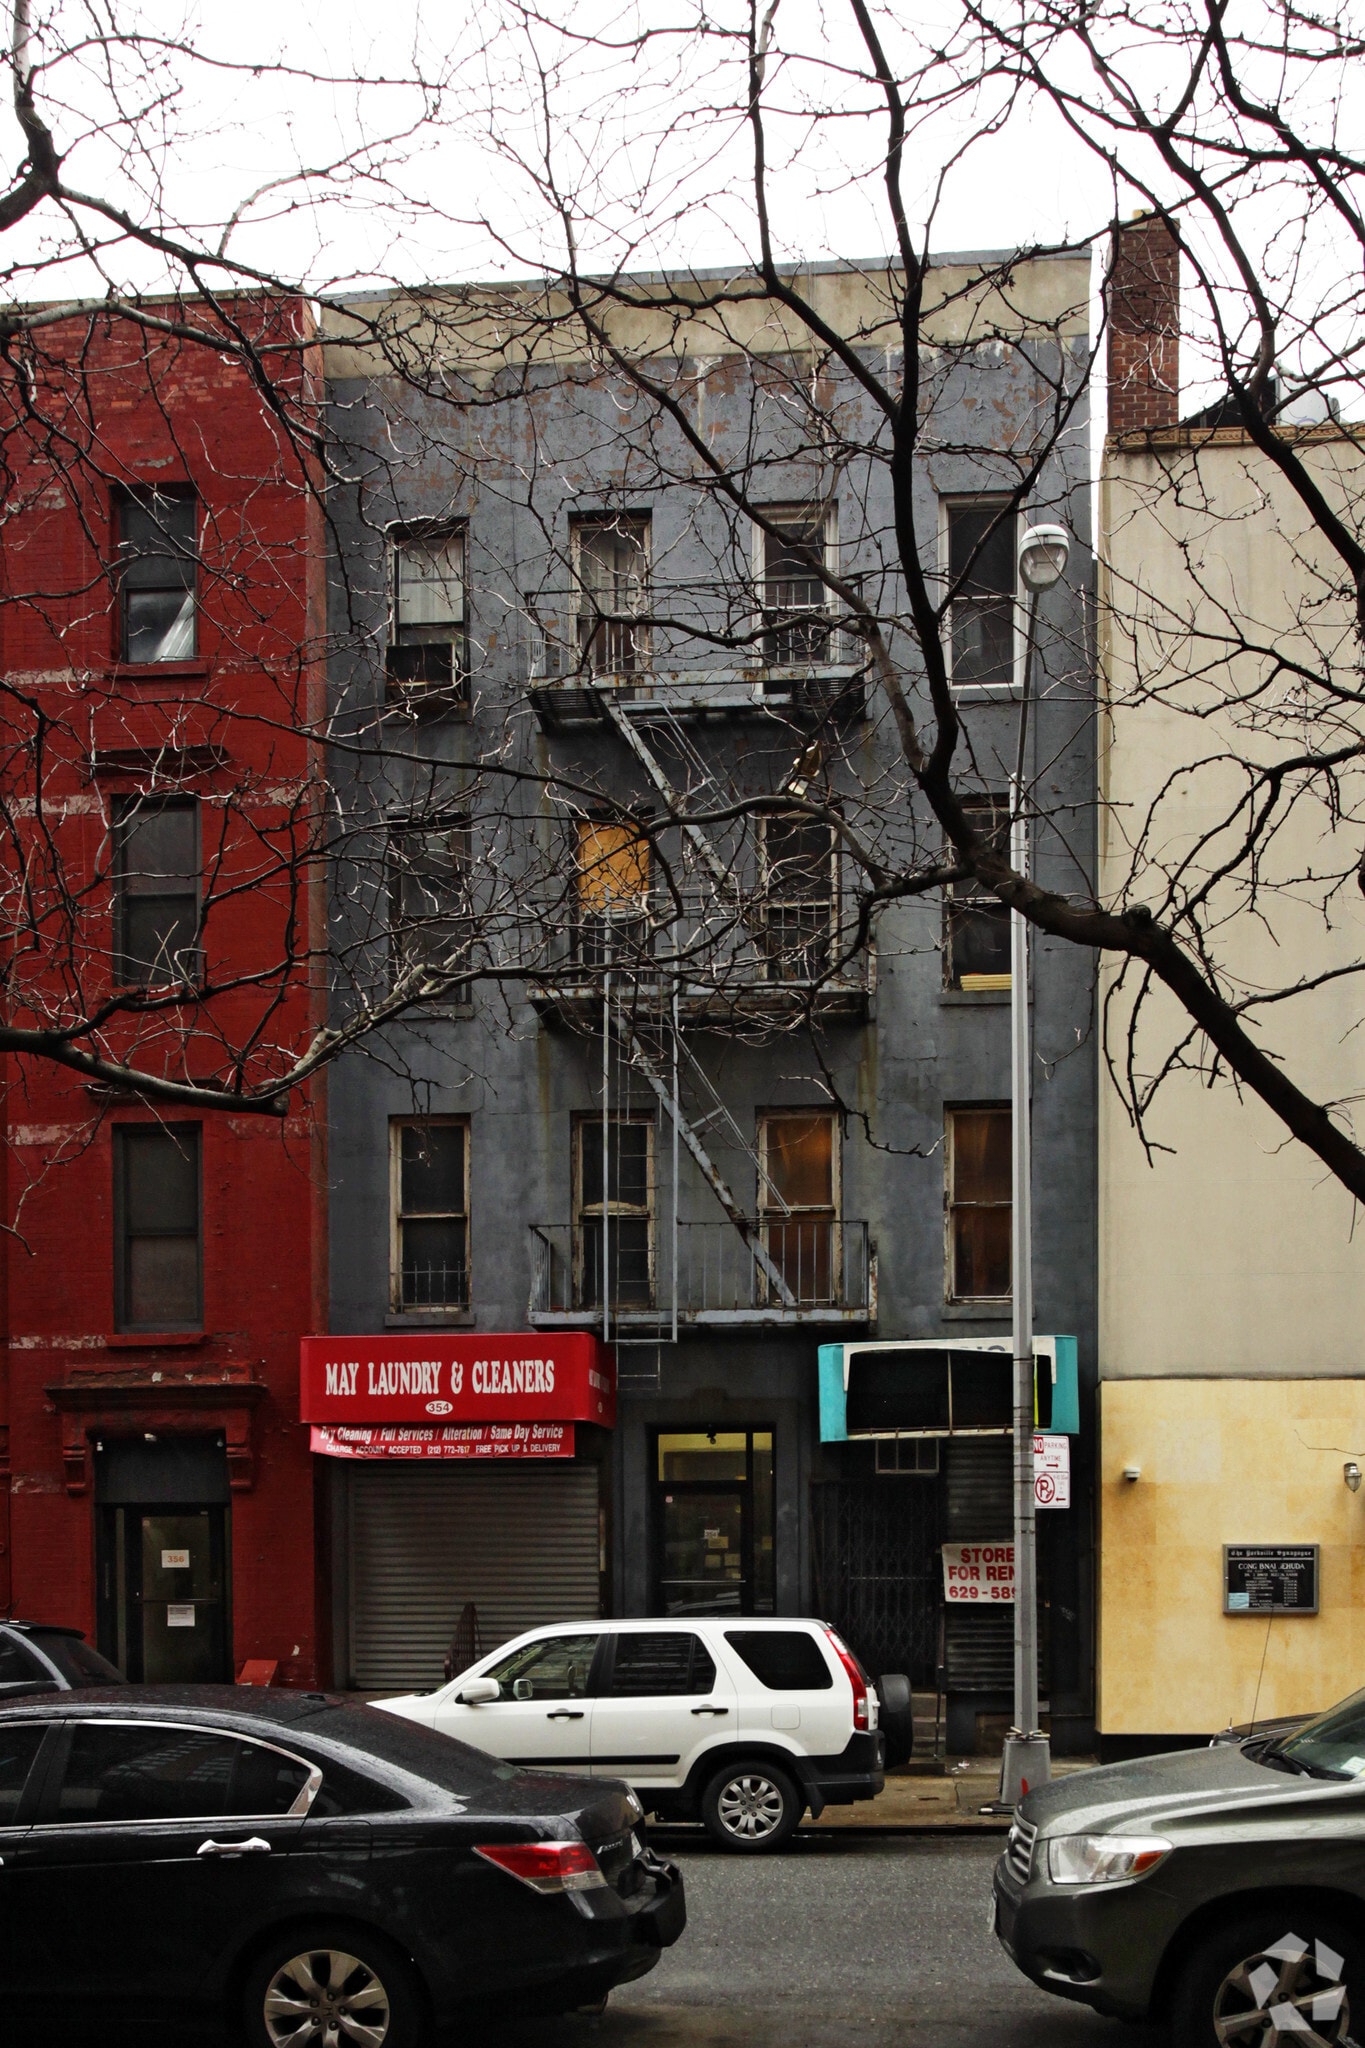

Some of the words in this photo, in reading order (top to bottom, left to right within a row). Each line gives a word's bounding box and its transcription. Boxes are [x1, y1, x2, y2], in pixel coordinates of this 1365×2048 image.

[325, 1362, 359, 1395] MAY
[367, 1361, 442, 1395] LAUNDRY
[450, 1361, 463, 1394] &
[472, 1359, 555, 1394] CLEANERS
[428, 1403, 450, 1412] 354
[320, 1426, 335, 1443] Dry
[337, 1426, 372, 1444] Cleaning
[381, 1427, 396, 1441] Full
[398, 1427, 433, 1441] Services
[442, 1427, 482, 1440] Alteration
[491, 1425, 512, 1439] Same
[514, 1424, 530, 1442] Day
[532, 1424, 563, 1439] Service
[326, 1444, 353, 1454] CHARGE
[355, 1445, 386, 1454] ACCOUNT
[388, 1445, 422, 1454] ACCEPTED
[427, 1445, 441, 1454] (212)
[475, 1444, 492, 1453] FREE
[494, 1444, 508, 1453] PICK
[512, 1444, 520, 1452] UP
[530, 1443, 561, 1452] DELIVERY
[1033, 1438, 1044, 1451] NO
[1044, 1441, 1067, 1450] PARKING
[961, 1547, 1015, 1563] STORE
[948, 1566, 980, 1581] FOR
[986, 1566, 1015, 1581] REN
